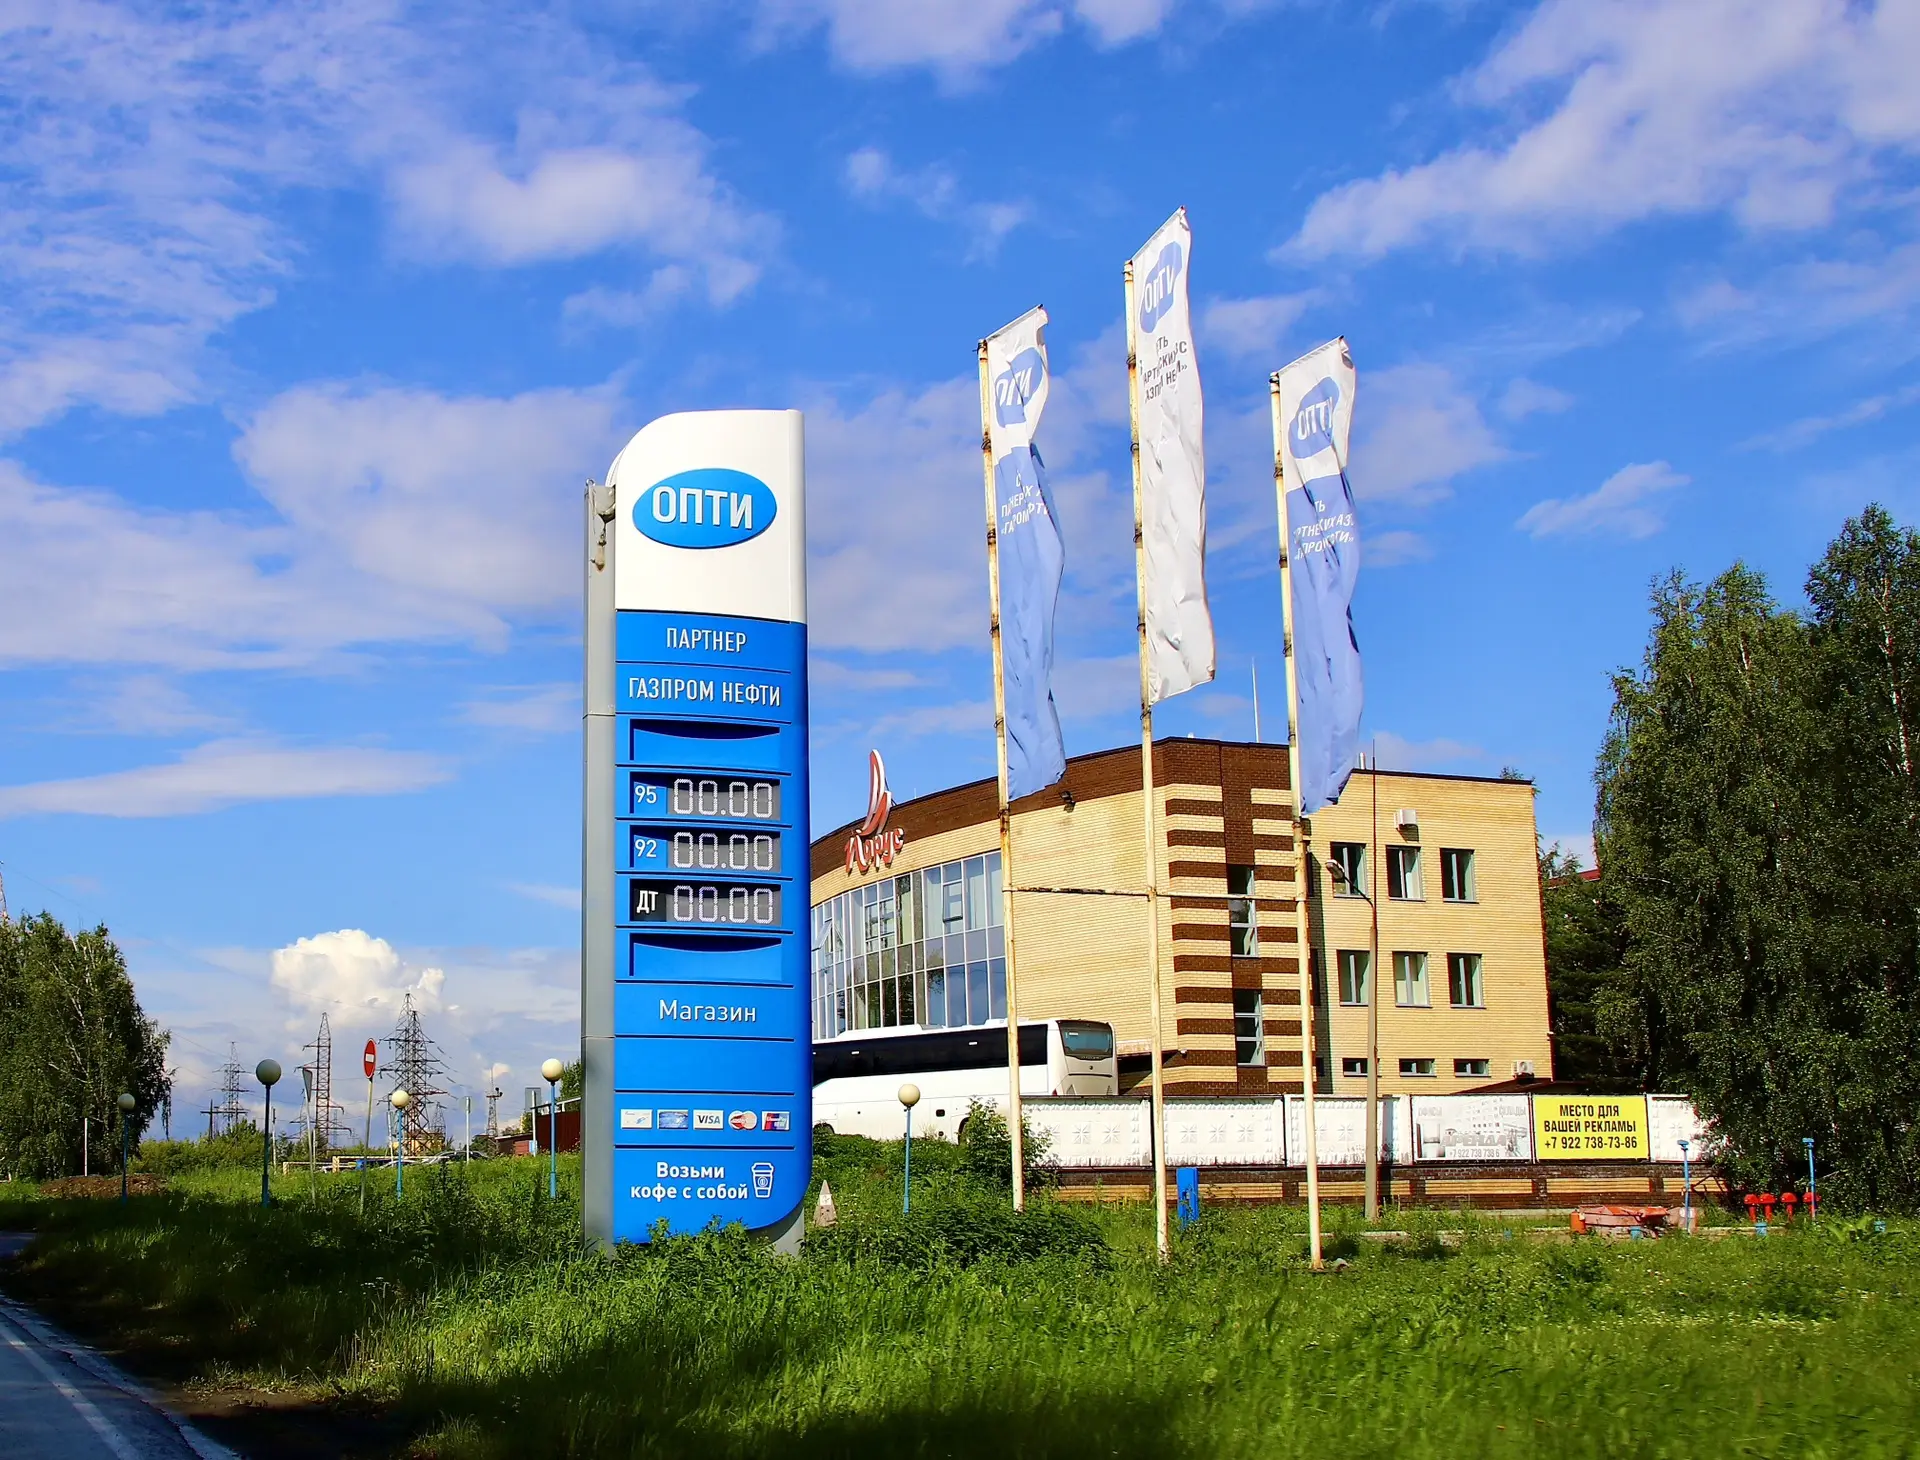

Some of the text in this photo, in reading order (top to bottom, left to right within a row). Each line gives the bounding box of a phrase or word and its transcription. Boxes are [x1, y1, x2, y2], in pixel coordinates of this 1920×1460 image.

[652, 486, 753, 529] ОПТИ
[666, 627, 747, 653] ПАРТНЕР
[628, 677, 781, 707] ГАЗПРОМ НЕФТИ
[635, 778, 772, 818] 95 00.00
[635, 832, 772, 870] 92 00.00
[637, 885, 773, 923] ДТ 00.00
[659, 1000, 757, 1022] Магазин
[698, 1114, 721, 1125] VISA
[1559, 1105, 1619, 1119] МЕСТО ДЛЯ
[1544, 1118, 1636, 1132] ВАШЕЙ РЕКЛАМЫ
[1544, 1136, 1638, 1149] +7 922 738-73-86
[1457, 1149, 1469, 1158] 922
[656, 1162, 725, 1179] Возьми
[630, 1183, 749, 1202] кофе с собой
